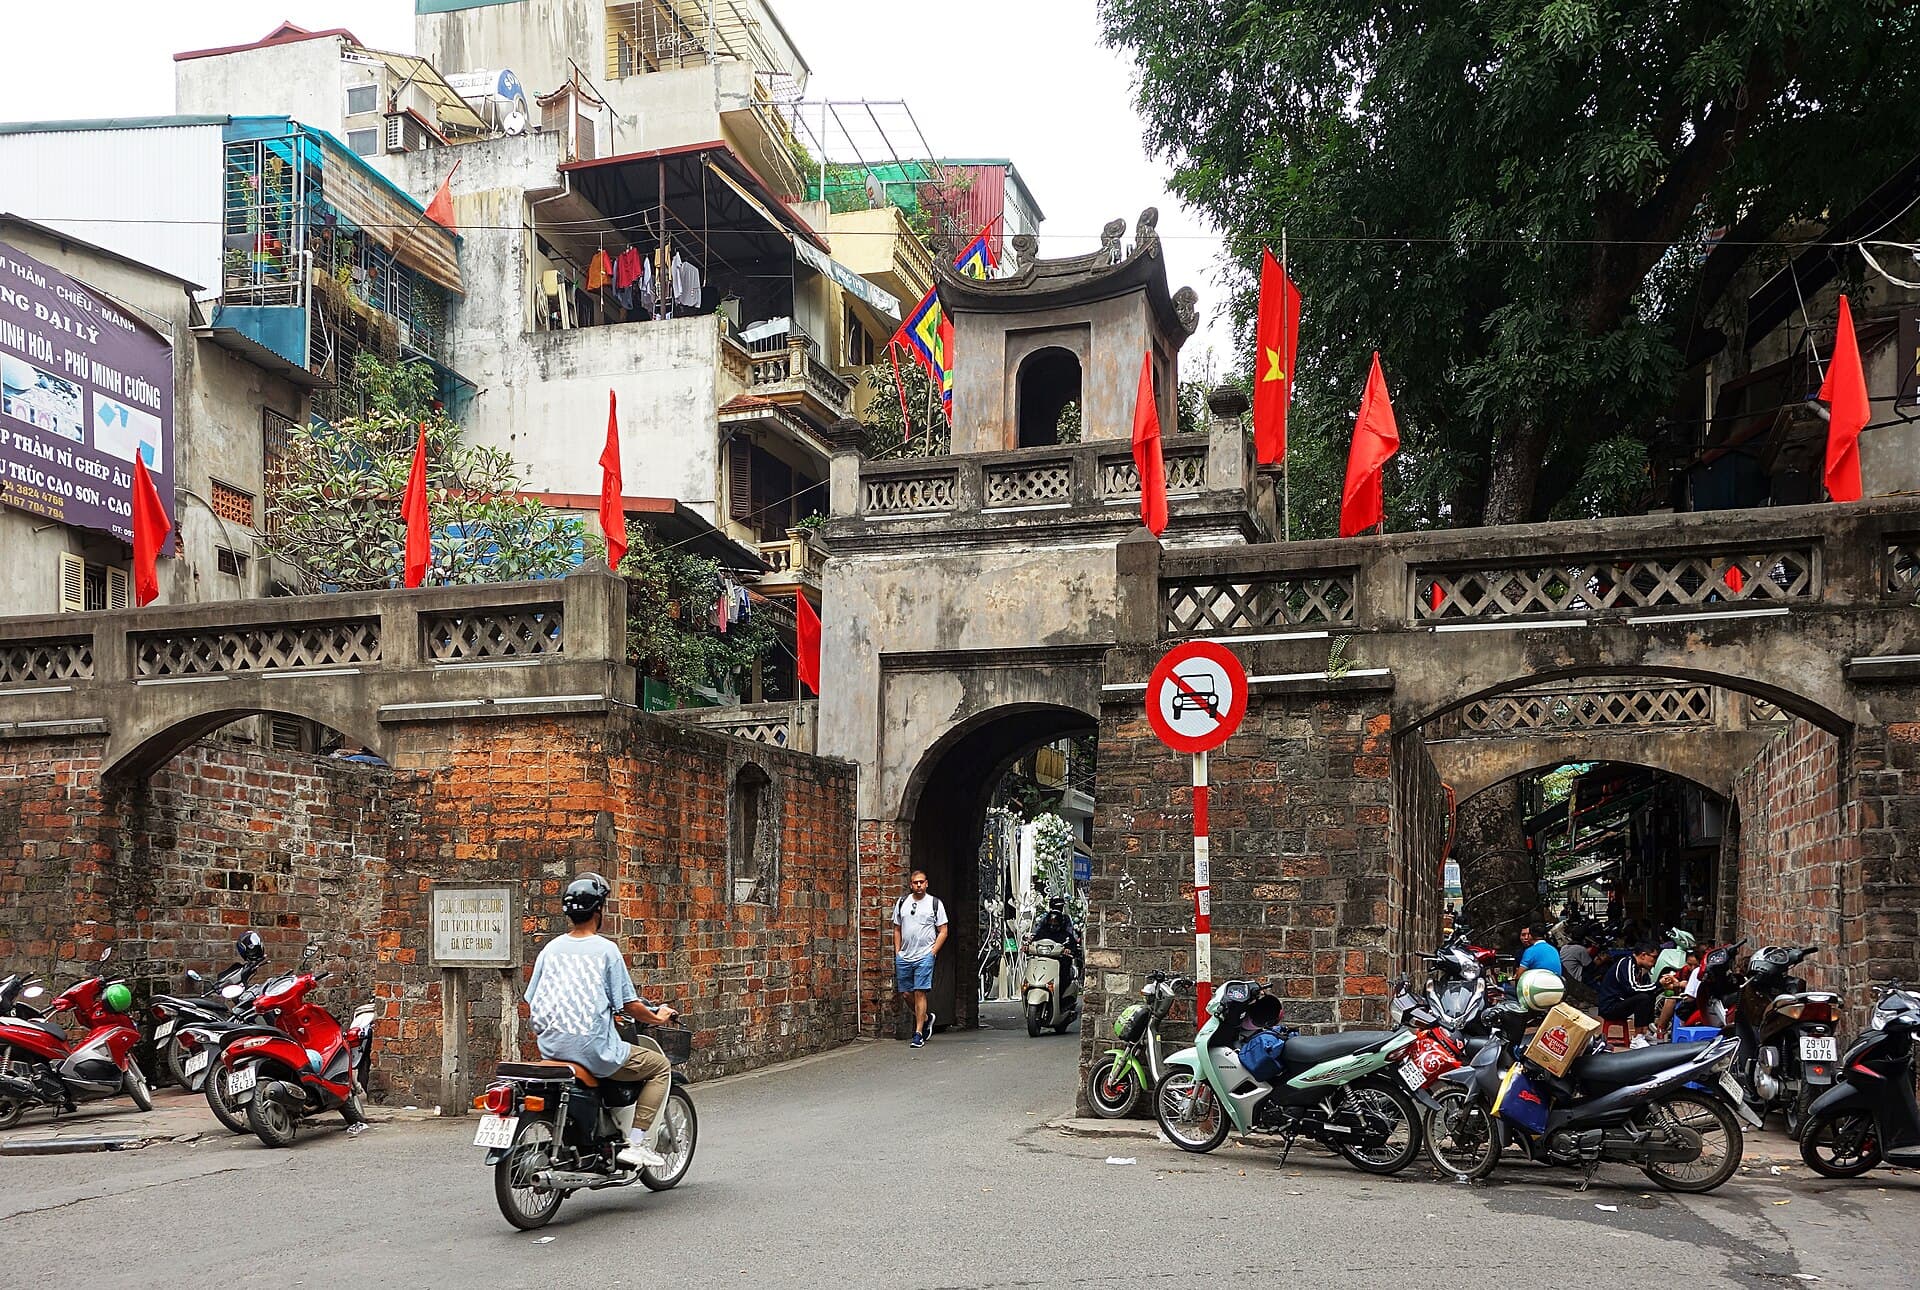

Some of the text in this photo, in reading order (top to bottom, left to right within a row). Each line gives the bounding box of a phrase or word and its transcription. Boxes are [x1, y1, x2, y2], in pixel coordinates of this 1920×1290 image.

[9, 260, 46, 289] THẢM
[34, 302, 72, 333] ĐẠI
[28, 331, 54, 365] HÒA
[91, 360, 122, 394] MINH
[124, 375, 161, 410] CƯỜNG
[9, 461, 45, 488] TRÚC
[47, 475, 73, 497] CAO
[107, 496, 132, 517] CAO
[112, 466, 131, 489] ÂU
[1806, 1050, 1832, 1059] 5076
